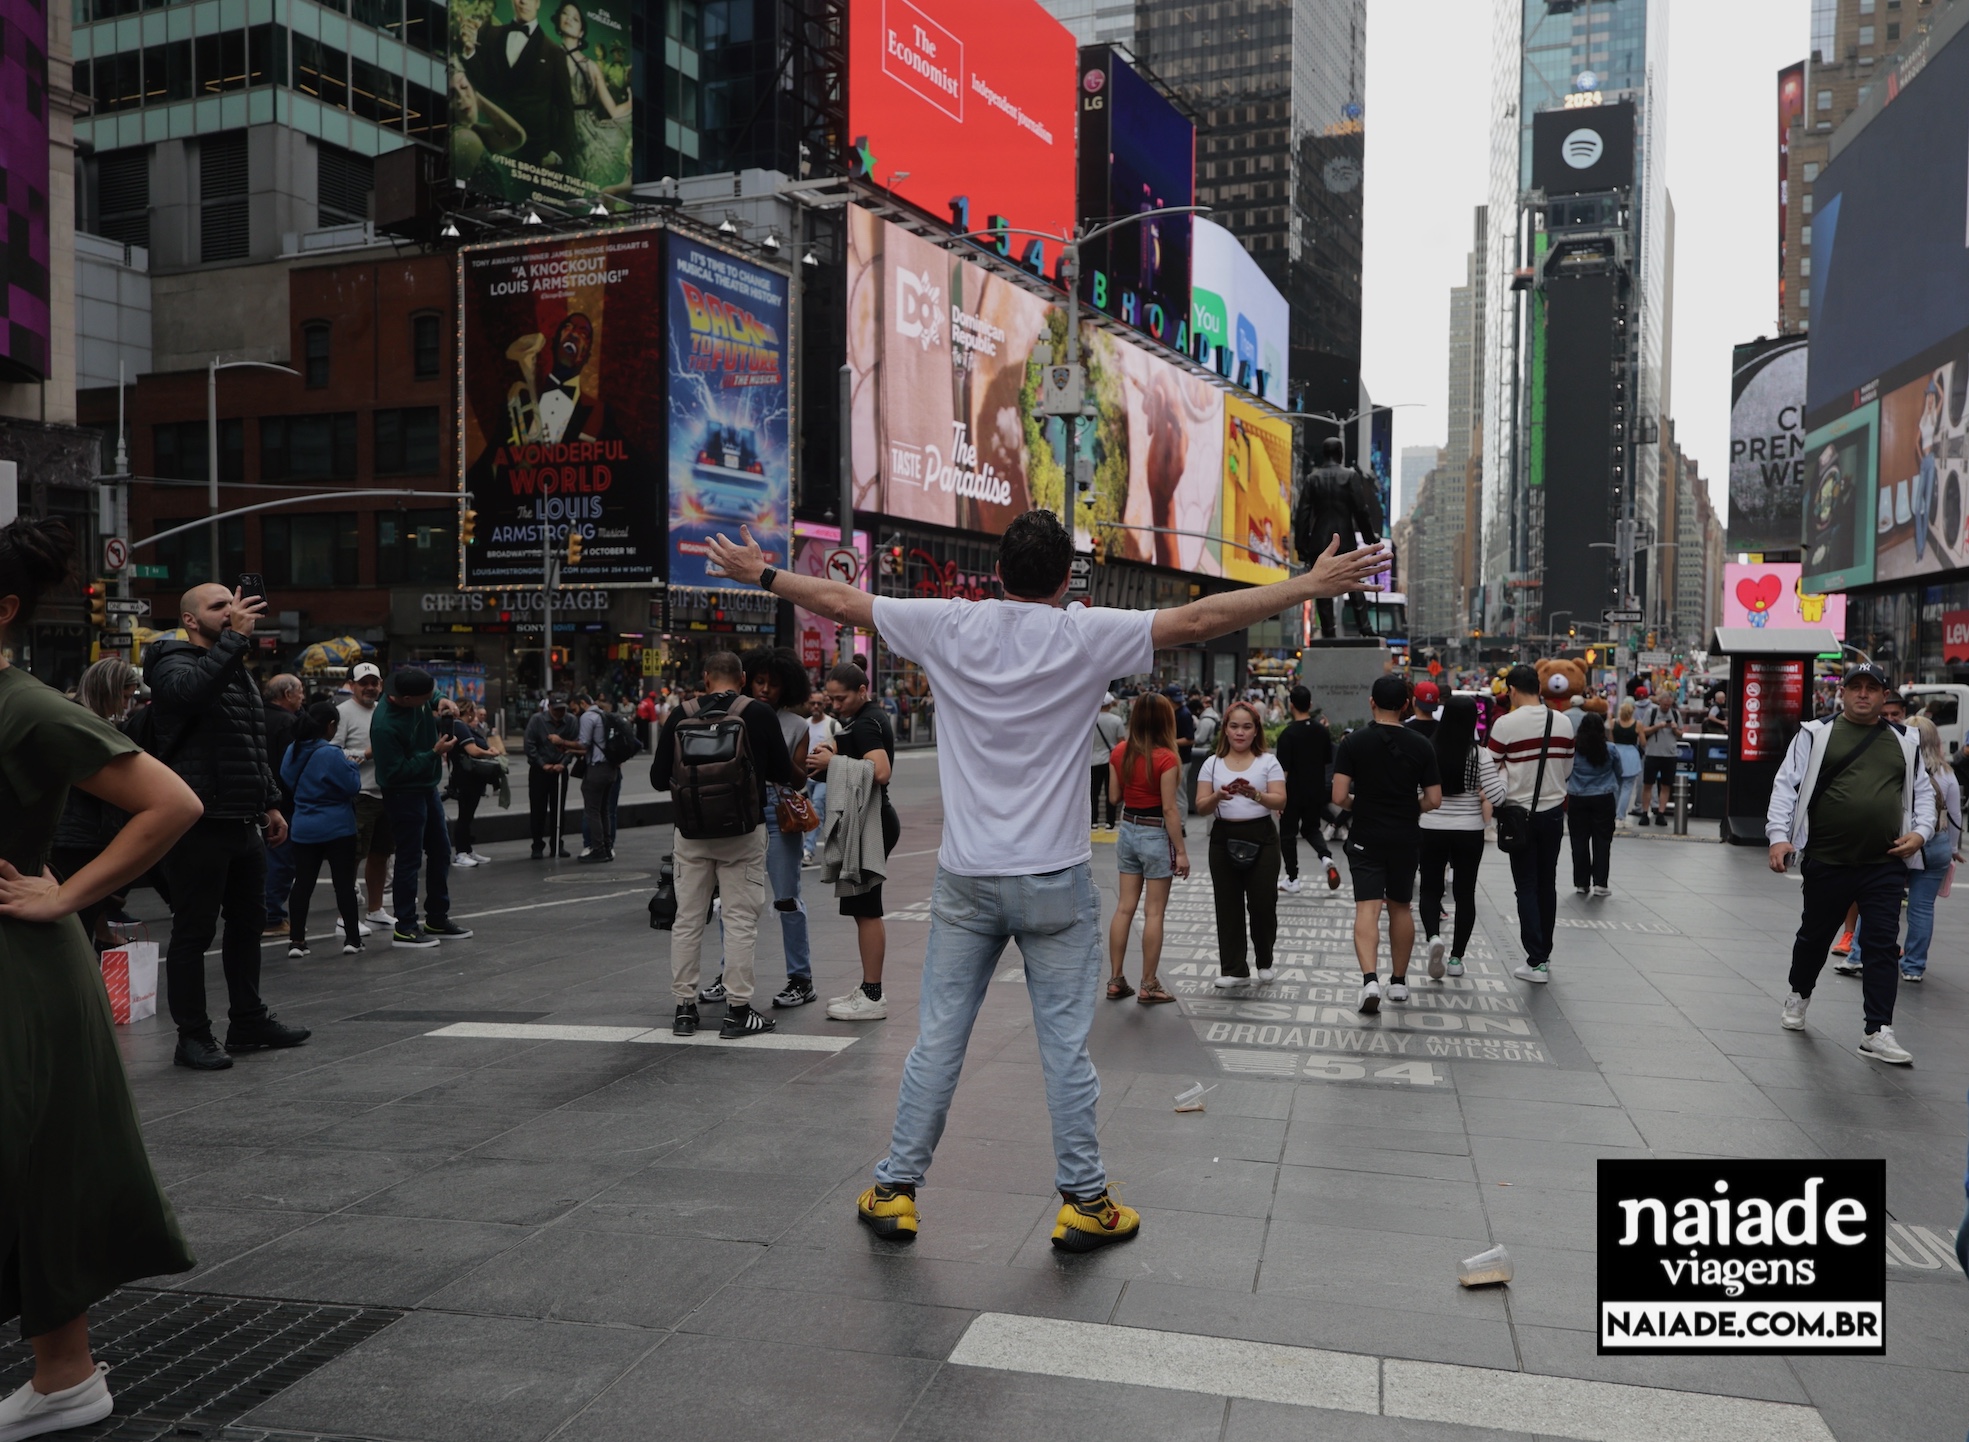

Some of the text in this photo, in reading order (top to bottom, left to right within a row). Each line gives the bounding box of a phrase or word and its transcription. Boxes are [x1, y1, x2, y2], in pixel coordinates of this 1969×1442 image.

[912, 24, 937, 58] The
[887, 28, 959, 98] Economist
[971, 72, 1053, 145] Independent journalism
[1084, 96, 1103, 110] LG
[1564, 90, 1603, 109] 2024
[517, 162, 564, 183] BROADWAY
[565, 174, 601, 193] THEATRE
[540, 177, 587, 198] BROADWAY
[472, 259, 490, 268] TONY
[522, 252, 550, 262] WINNER
[551, 250, 572, 260] JAMES
[605, 241, 641, 253] IGLEHART
[641, 240, 649, 249] IS
[530, 256, 606, 278] KNOCKOUT
[676, 258, 782, 307] MUSICAL THEATER HISTORY
[707, 256, 726, 271] TIME
[727, 264, 738, 279] TO
[738, 269, 772, 292] CHANGE
[490, 280, 529, 297] LOUIS
[678, 278, 778, 347] BACK
[951, 304, 1006, 344] Dominican
[1192, 303, 1221, 335] You
[690, 332, 712, 355] TO
[951, 323, 997, 358] Republic
[1090, 269, 1269, 398] BROADWAY
[710, 338, 779, 373] FUTURE
[749, 374, 778, 385] MUSICAL
[494, 439, 628, 466] A WONDERFUL
[952, 419, 978, 467] The
[891, 448, 922, 480] TASTE
[923, 444, 1013, 507] Paradise
[509, 464, 612, 495] WORLD
[517, 495, 603, 521] The LOUIS
[491, 522, 596, 543] ARMSTROG
[486, 549, 526, 558] BROADWAY
[589, 547, 624, 557] OCTOBER
[130, 603, 145, 612] WAY
[421, 591, 610, 612] GIFTS LUGGAGE
[667, 590, 779, 614] GIFTS LUGGAGE
[516, 624, 546, 632] SONY
[735, 625, 758, 633] SONY
[1750, 663, 1799, 673] Welcome!
[1505, 914, 1683, 934] HSCHFELD
[1308, 986, 1521, 1013] GEHWIN
[1236, 1002, 1532, 1036] SIMON
[1205, 1021, 1412, 1054] BROADWAY
[1426, 1034, 1537, 1050] AUGUST
[1426, 1042, 1546, 1063] WILSON
[1302, 1054, 1444, 1086] 54
